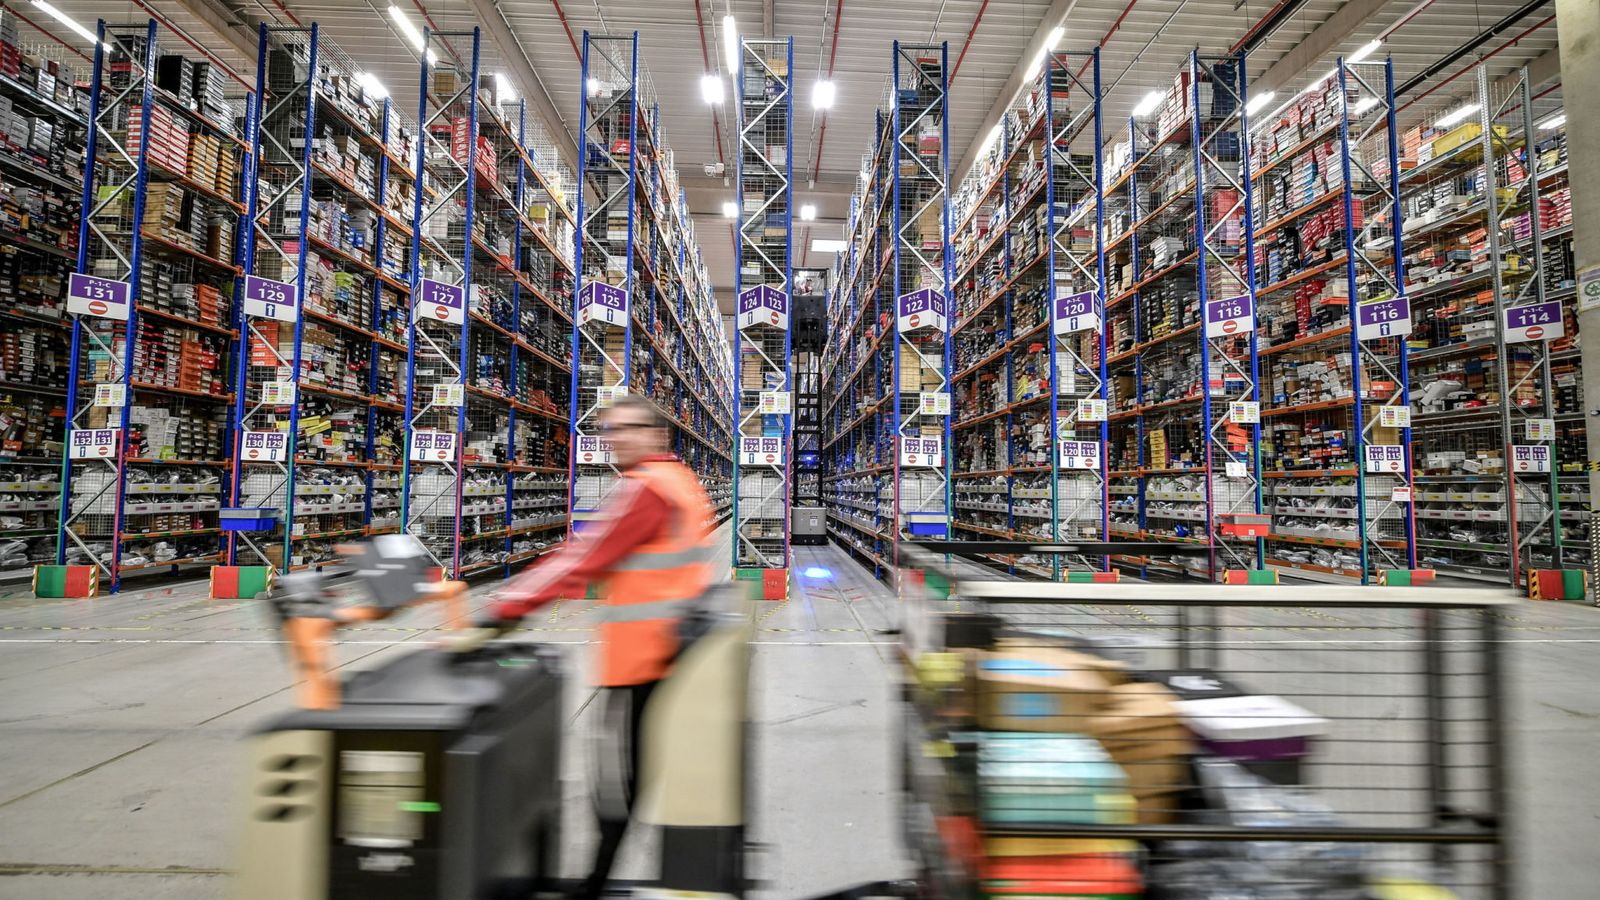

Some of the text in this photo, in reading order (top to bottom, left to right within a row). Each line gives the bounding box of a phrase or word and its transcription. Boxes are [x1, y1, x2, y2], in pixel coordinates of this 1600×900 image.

[89, 280, 110, 288] P-1-C
[262, 282, 281, 290] P-1-C
[436, 284, 451, 293] P-1-C
[84, 286, 114, 300] 131
[258, 288, 285, 302] 129
[432, 291, 454, 305] 127
[581, 292, 590, 306] 126
[908, 294, 920, 302] P-1-C
[601, 293, 620, 307] 125
[744, 297, 757, 310] 124
[768, 297, 782, 310] 123
[906, 300, 923, 313] 122
[934, 300, 942, 313] 121
[1067, 296, 1081, 304] P-1-C
[1220, 300, 1237, 308] P-1-C
[1064, 304, 1085, 316] 120
[1218, 306, 1242, 319] 118
[1370, 308, 1398, 322] 116
[1519, 312, 1550, 324] 114
